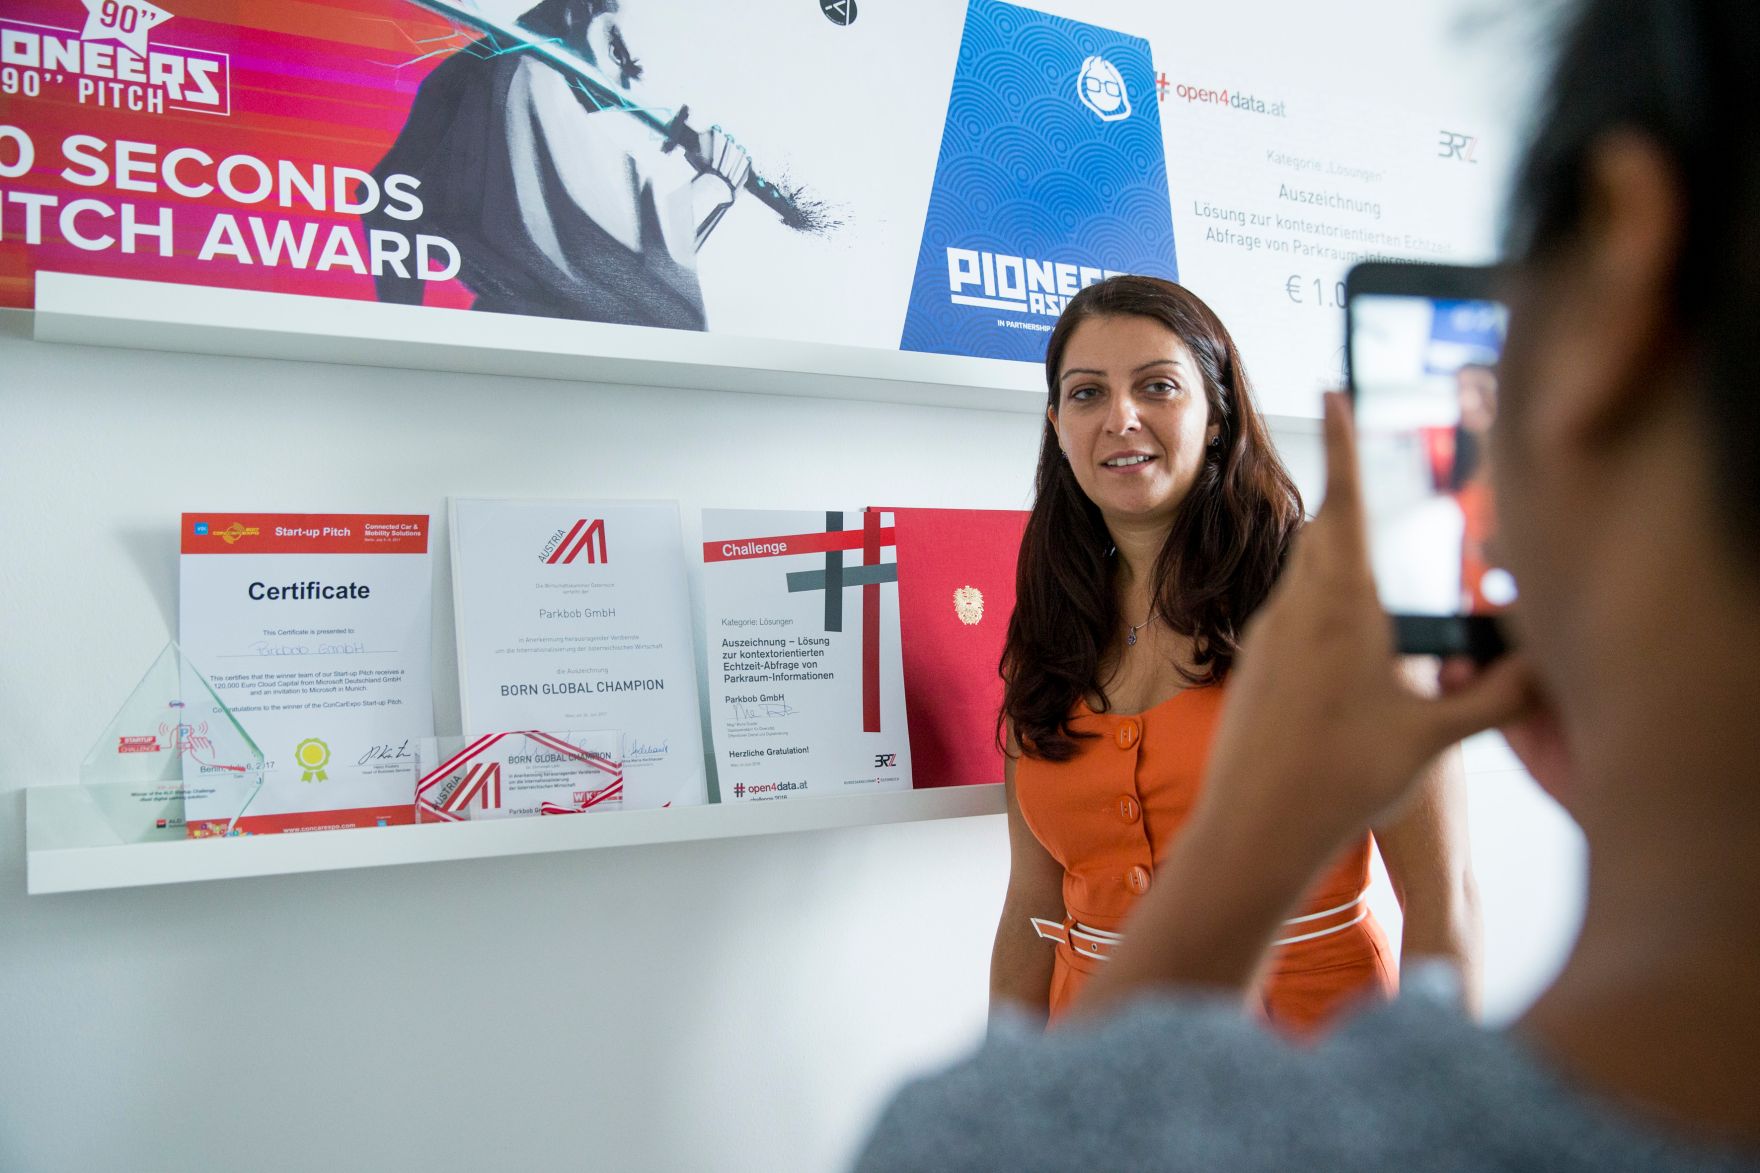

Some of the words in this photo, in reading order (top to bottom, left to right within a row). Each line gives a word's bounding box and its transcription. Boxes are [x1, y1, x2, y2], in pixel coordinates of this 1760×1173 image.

[79, 78, 164, 115] PITCH
[1176, 81, 1287, 118] open4data.at
[1266, 149, 1322, 173] Kategorie
[61, 134, 424, 221] SECONDS
[1278, 183, 1382, 220] Auszeichnung
[1194, 200, 1246, 226] Lösung
[1250, 214, 1272, 227] zur
[1276, 214, 1400, 249] kontextorientierten
[1206, 227, 1262, 250] Abfrage
[1266, 239, 1289, 252] von
[198, 212, 462, 282] AWARD
[1286, 274, 1303, 304] €
[1006, 321, 1050, 332] PARTNERSHIP
[275, 526, 320, 538] Start-up
[323, 526, 351, 537] Pitch
[365, 530, 390, 538] Mobility
[538, 529, 566, 563] AUSTRIA
[722, 541, 787, 557] Challenge
[248, 581, 370, 601] Certificate
[539, 608, 582, 619] Parkbob
[584, 608, 616, 618] GmbH
[721, 618, 758, 628] Kategorie:
[759, 617, 794, 627] Lösungen
[317, 628, 346, 636] presented
[721, 638, 786, 648] Auszeichnung
[798, 637, 830, 646] Lösung
[722, 652, 737, 660] zur
[740, 648, 825, 659] kontextorientierten
[567, 666, 609, 675] Auszeichnung
[723, 660, 800, 671] Echtzeit-Abfrage
[801, 661, 818, 669] von
[278, 680, 299, 688] Capital
[724, 671, 834, 684] Parkraum-Informationen
[501, 684, 539, 696] BORN
[542, 682, 593, 695] GLOBAL
[596, 679, 664, 693] CHAMPION
[363, 699, 386, 707] Start-up
[725, 695, 758, 703] Parkbob
[760, 694, 785, 702] GmbH
[508, 755, 532, 764] BORN
[534, 754, 567, 763] GLOBAL
[568, 751, 611, 762] CHAMPION
[729, 749, 765, 758] Herzliche
[766, 746, 809, 756] Gratulation!
[748, 780, 808, 794] open4data.at
[282, 822, 356, 834] www.concarexpo.com
